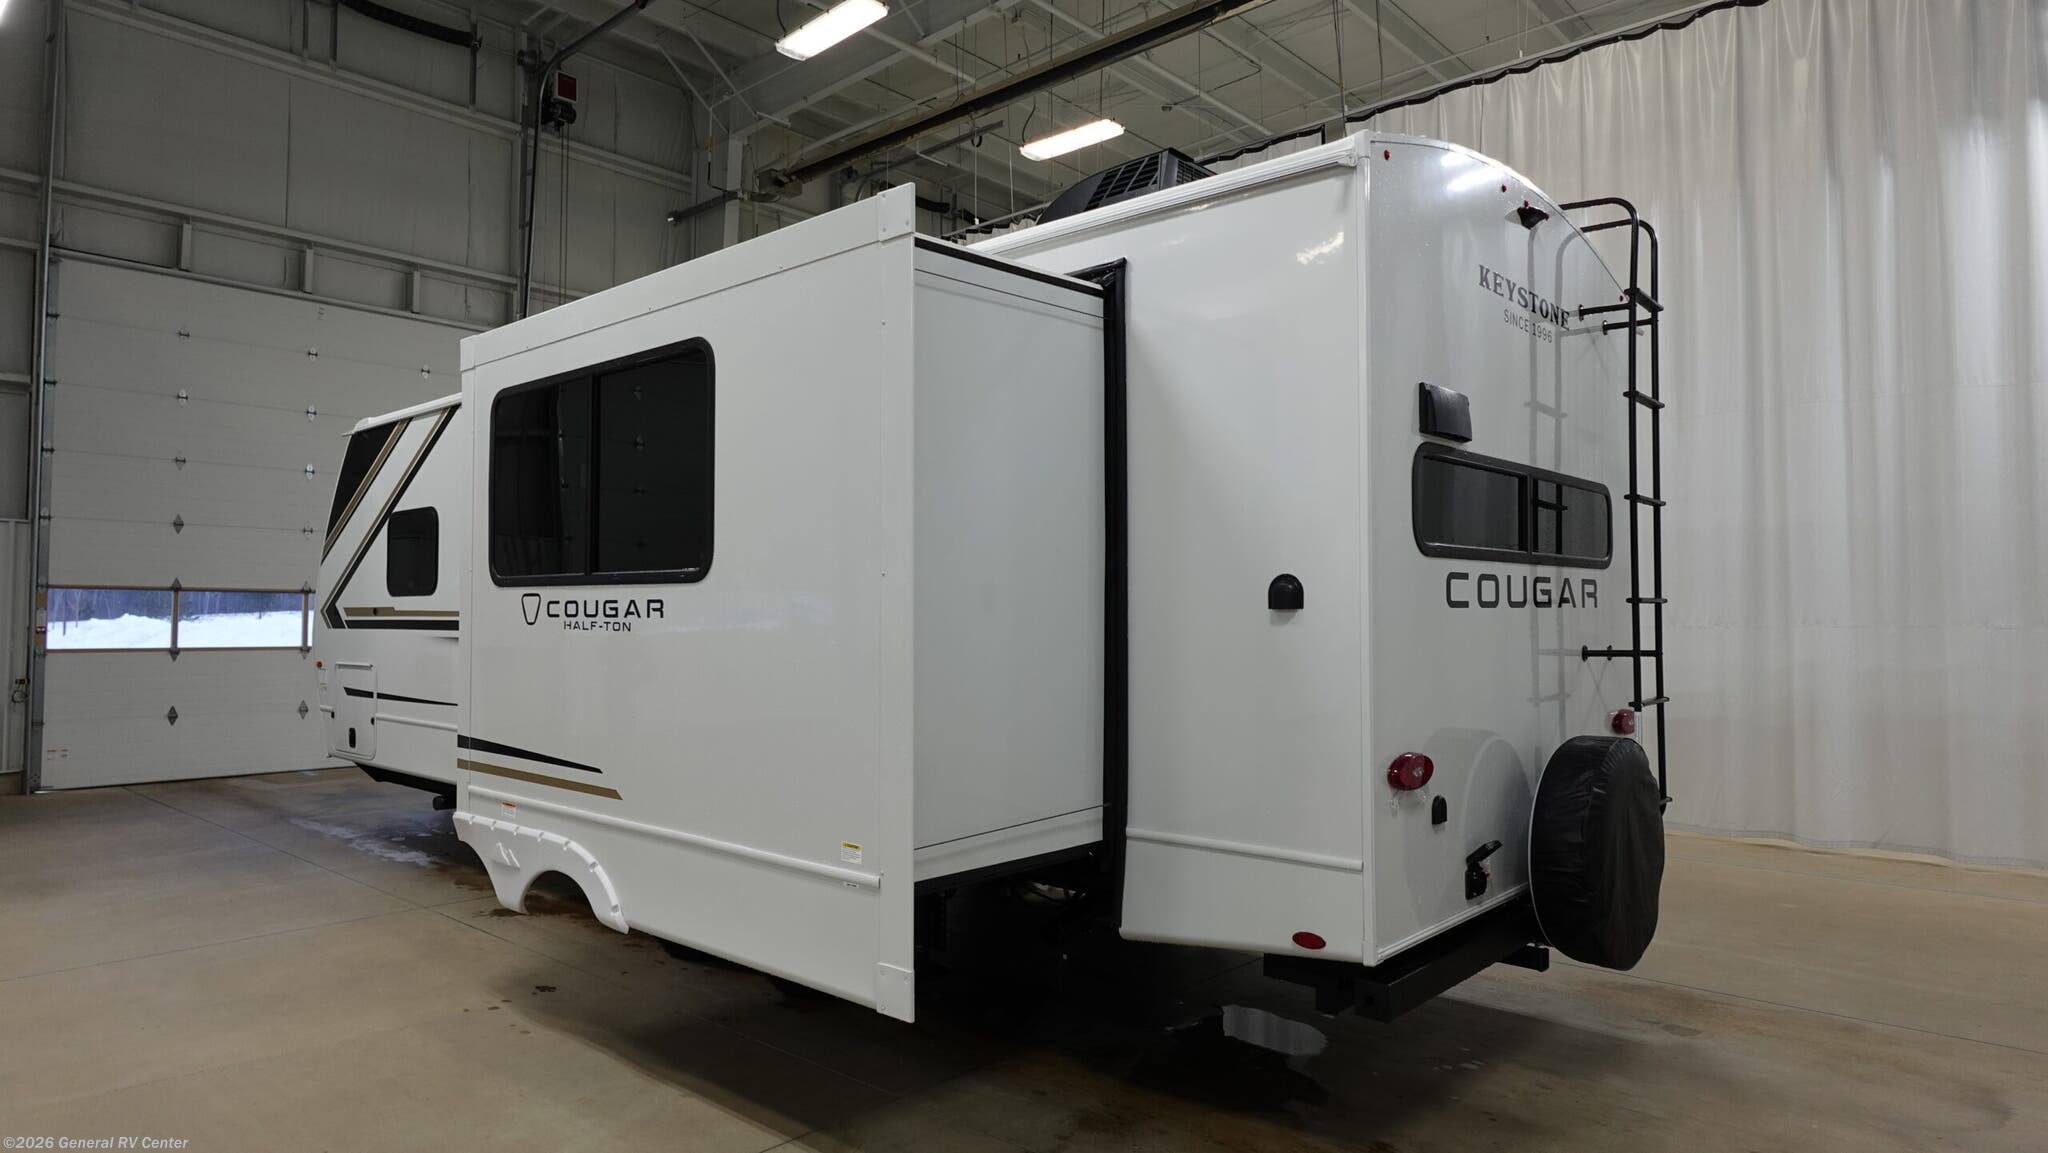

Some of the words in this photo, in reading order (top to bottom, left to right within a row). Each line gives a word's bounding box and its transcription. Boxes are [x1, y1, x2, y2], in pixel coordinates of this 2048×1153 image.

[1478, 264, 1570, 331] KEYSTONE
[1503, 308, 1529, 333] SINCE
[1531, 322, 1553, 344] 1996
[1445, 571, 1598, 609] COUGAR
[546, 599, 665, 619] COUGAR
[563, 620, 632, 632] HALF-TON
